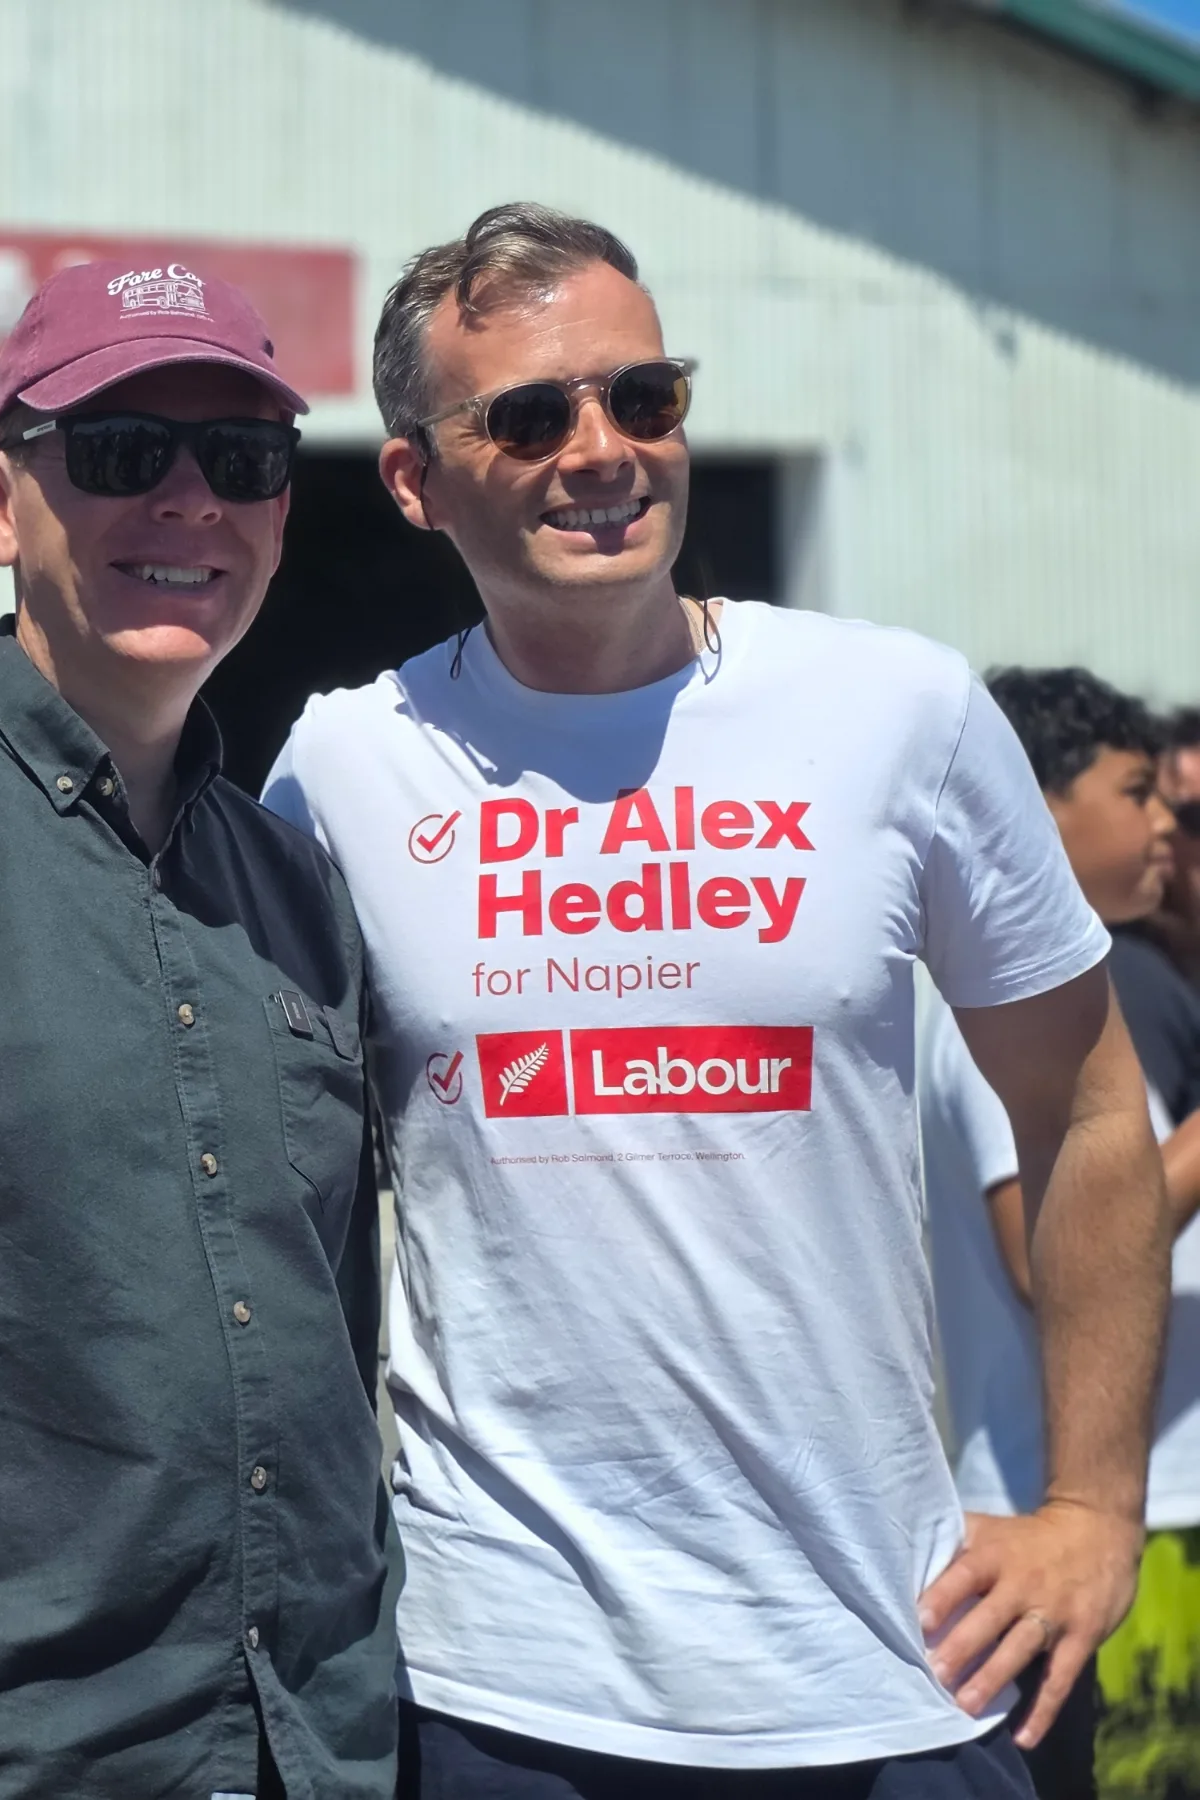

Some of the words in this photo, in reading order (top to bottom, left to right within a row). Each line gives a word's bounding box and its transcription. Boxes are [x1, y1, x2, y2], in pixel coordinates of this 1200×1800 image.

[107, 268, 163, 296] Fare
[479, 797, 579, 865] Dr
[599, 785, 817, 854] Alex
[477, 861, 807, 944] Hedley
[472, 962, 531, 997] for
[546, 956, 701, 999] Napier
[591, 1046, 792, 1098] Labour
[489, 1155, 537, 1166] Authorised
[538, 1155, 549, 1165] by
[551, 1154, 570, 1163] Rob
[617, 1152, 624, 1162] 2
